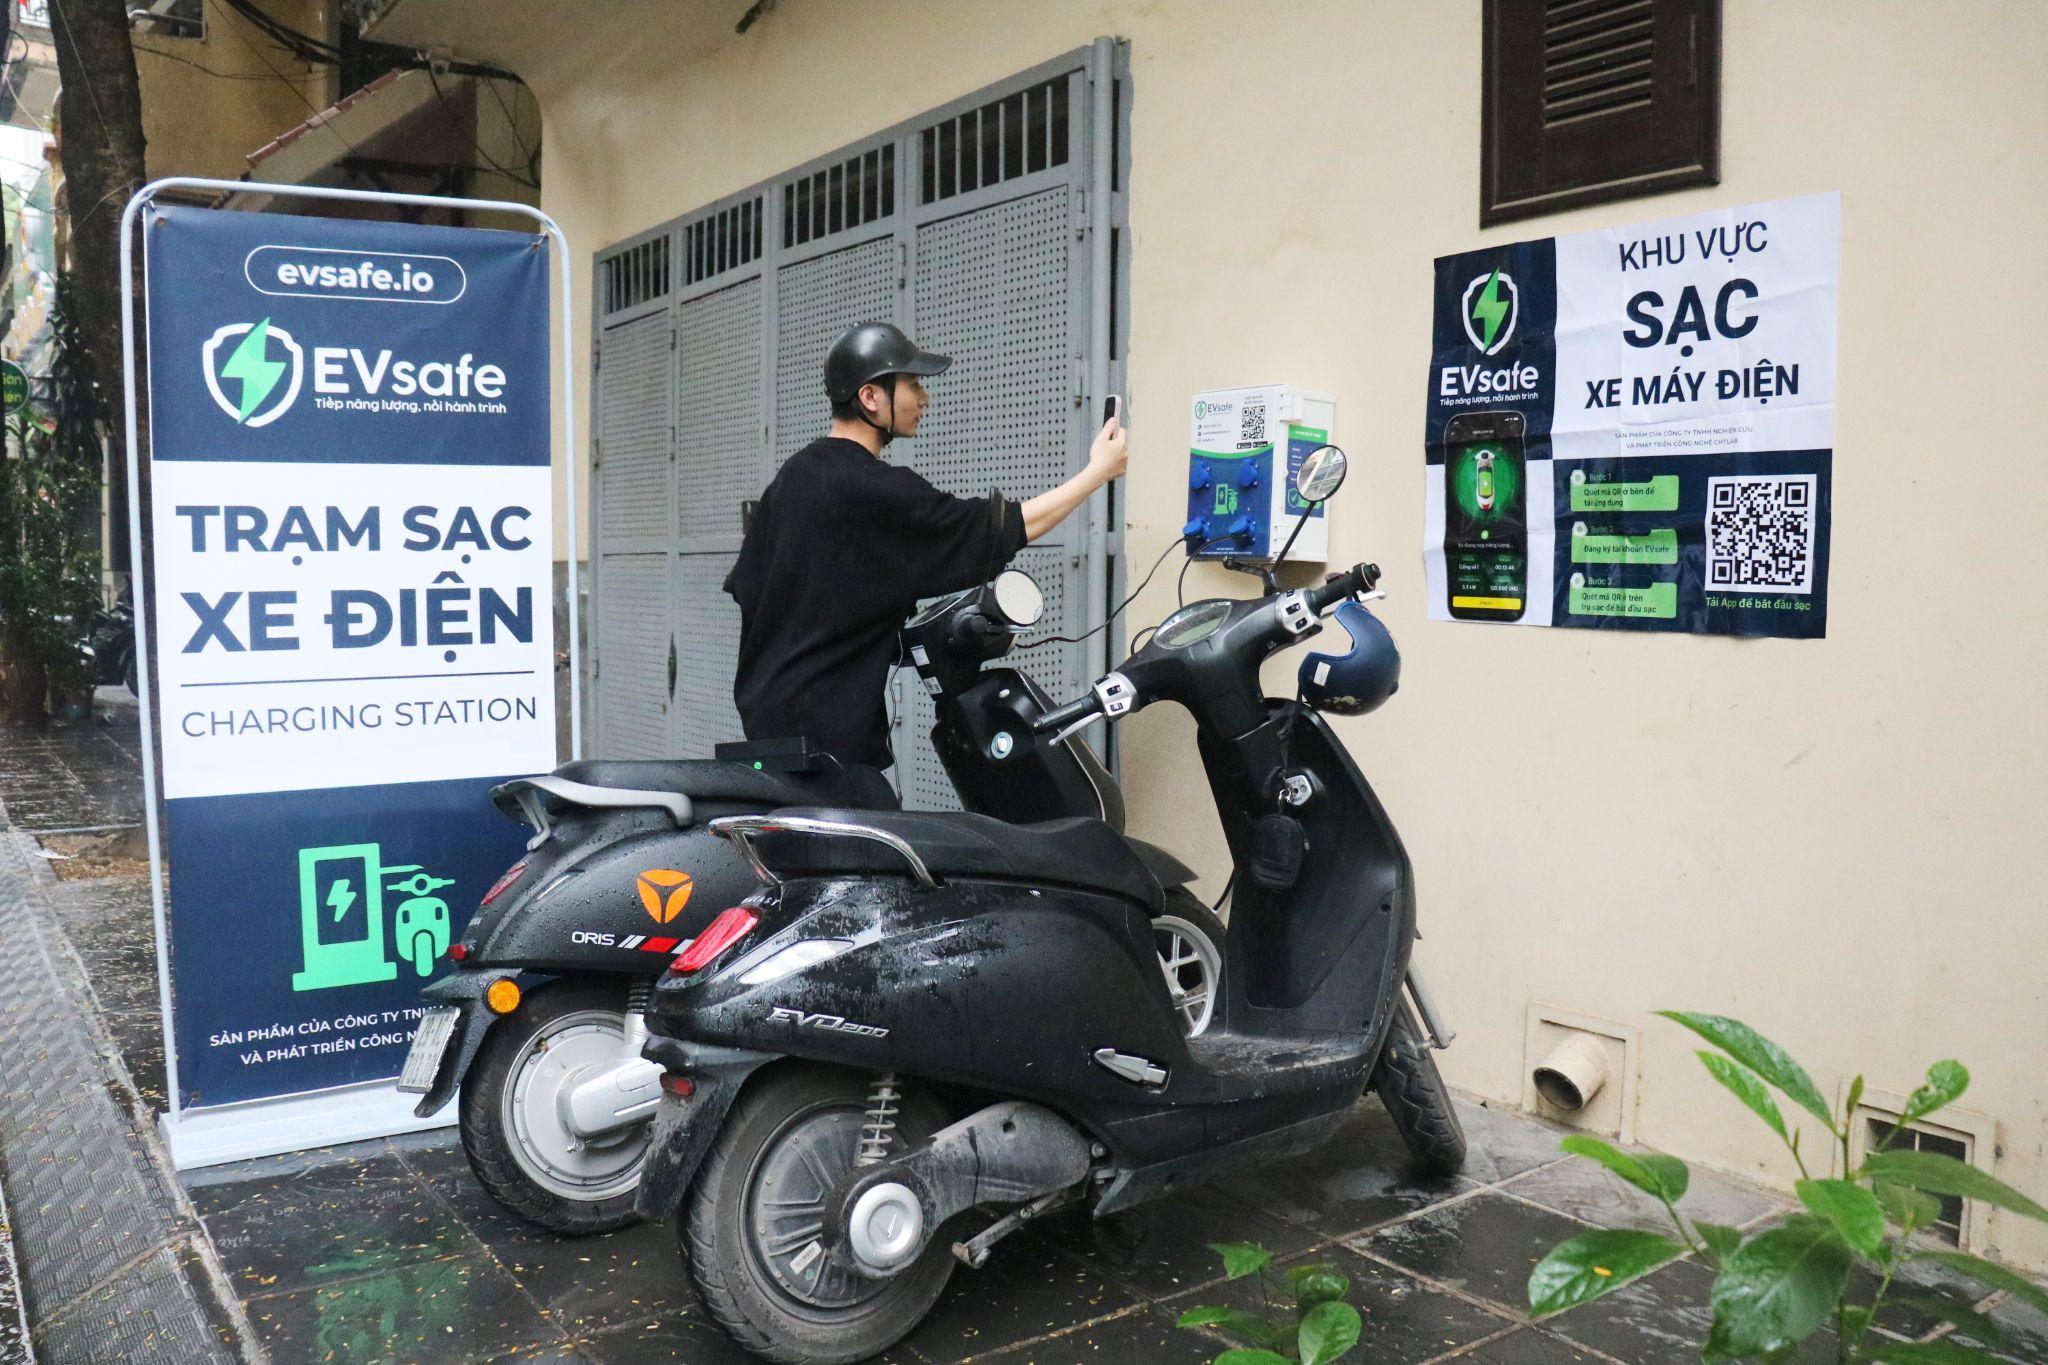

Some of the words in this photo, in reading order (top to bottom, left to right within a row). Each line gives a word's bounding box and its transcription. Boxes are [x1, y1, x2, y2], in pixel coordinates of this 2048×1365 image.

[1619, 233, 1685, 272] KHU
[1695, 221, 1768, 264] VỰC
[277, 261, 434, 293] evsafe.io
[1622, 278, 1759, 357] SẠC
[314, 347, 507, 397] EVsafe
[1440, 360, 1539, 396] EVsafe
[1585, 377, 1622, 409] XE
[1632, 366, 1706, 406] MÁY
[1715, 358, 1799, 405] ĐIỆN
[1207, 402, 1233, 413] EVsafe
[175, 505, 381, 567] TRẠM
[402, 505, 532, 565] SẠC
[180, 589, 300, 654] XE
[323, 571, 534, 663] ĐIỆN
[182, 703, 382, 738] CHARGING
[395, 696, 537, 727] STATION
[571, 931, 616, 946] ORIS
[209, 1030, 243, 1047] SẢN
[247, 1022, 295, 1042] PHẨM
[298, 1018, 331, 1034] CỦA
[334, 1014, 378, 1030] CÔNG
[381, 1010, 400, 1023] TY
[240, 1050, 263, 1065] VÀ
[267, 1044, 308, 1062] PHÁT
[311, 1036, 356, 1055] TRIỂN
[359, 1033, 403, 1048] CÔNG
